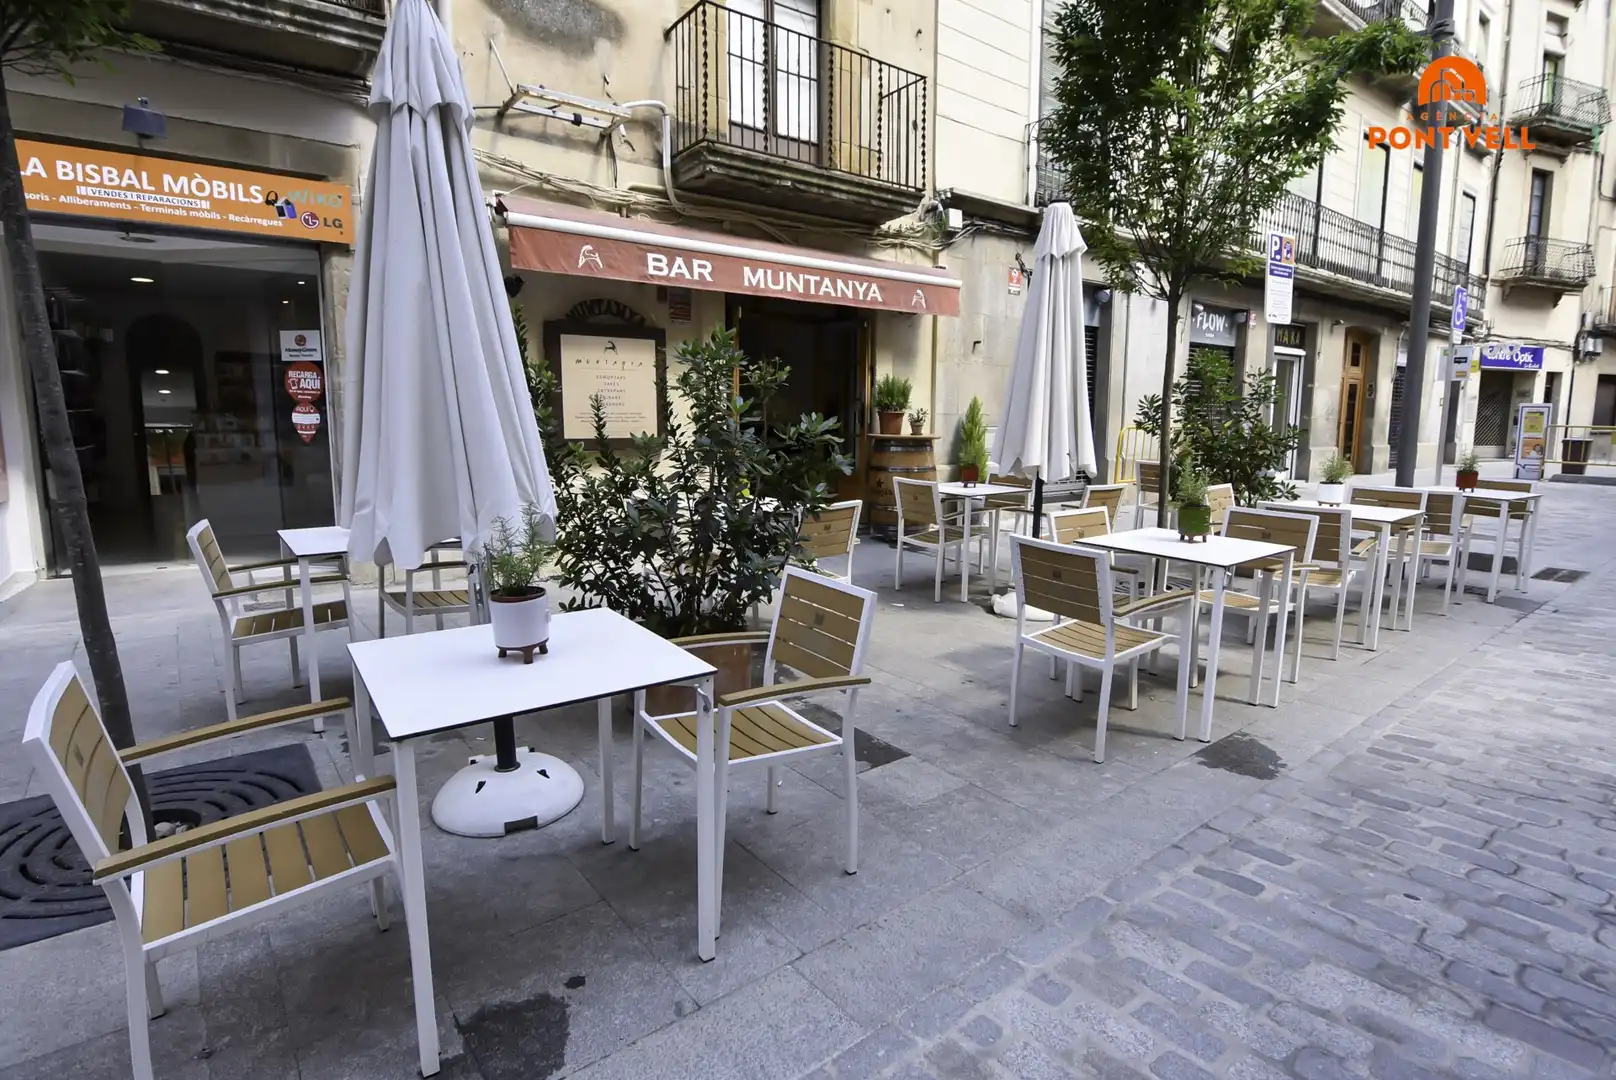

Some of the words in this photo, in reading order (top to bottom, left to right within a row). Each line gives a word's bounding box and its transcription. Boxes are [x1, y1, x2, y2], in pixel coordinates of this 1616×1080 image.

[21, 156, 48, 179] A
[55, 159, 156, 191] BISBAL
[162, 172, 265, 205] MÒBILS
[91, 188, 128, 199] VENDES
[136, 193, 199, 207] REPARACIONS
[24, 192, 50, 202] soris
[59, 194, 131, 211] Alliberaments
[140, 203, 188, 216] Terminals
[190, 209, 221, 220] mòbils
[228, 213, 283, 227] Recàrregues
[324, 217, 343, 229] LG
[646, 252, 714, 282] BAR
[743, 265, 883, 302] MUNTANYA
[1196, 311, 1226, 332] FLOW
[288, 370, 317, 379] RECARGA
